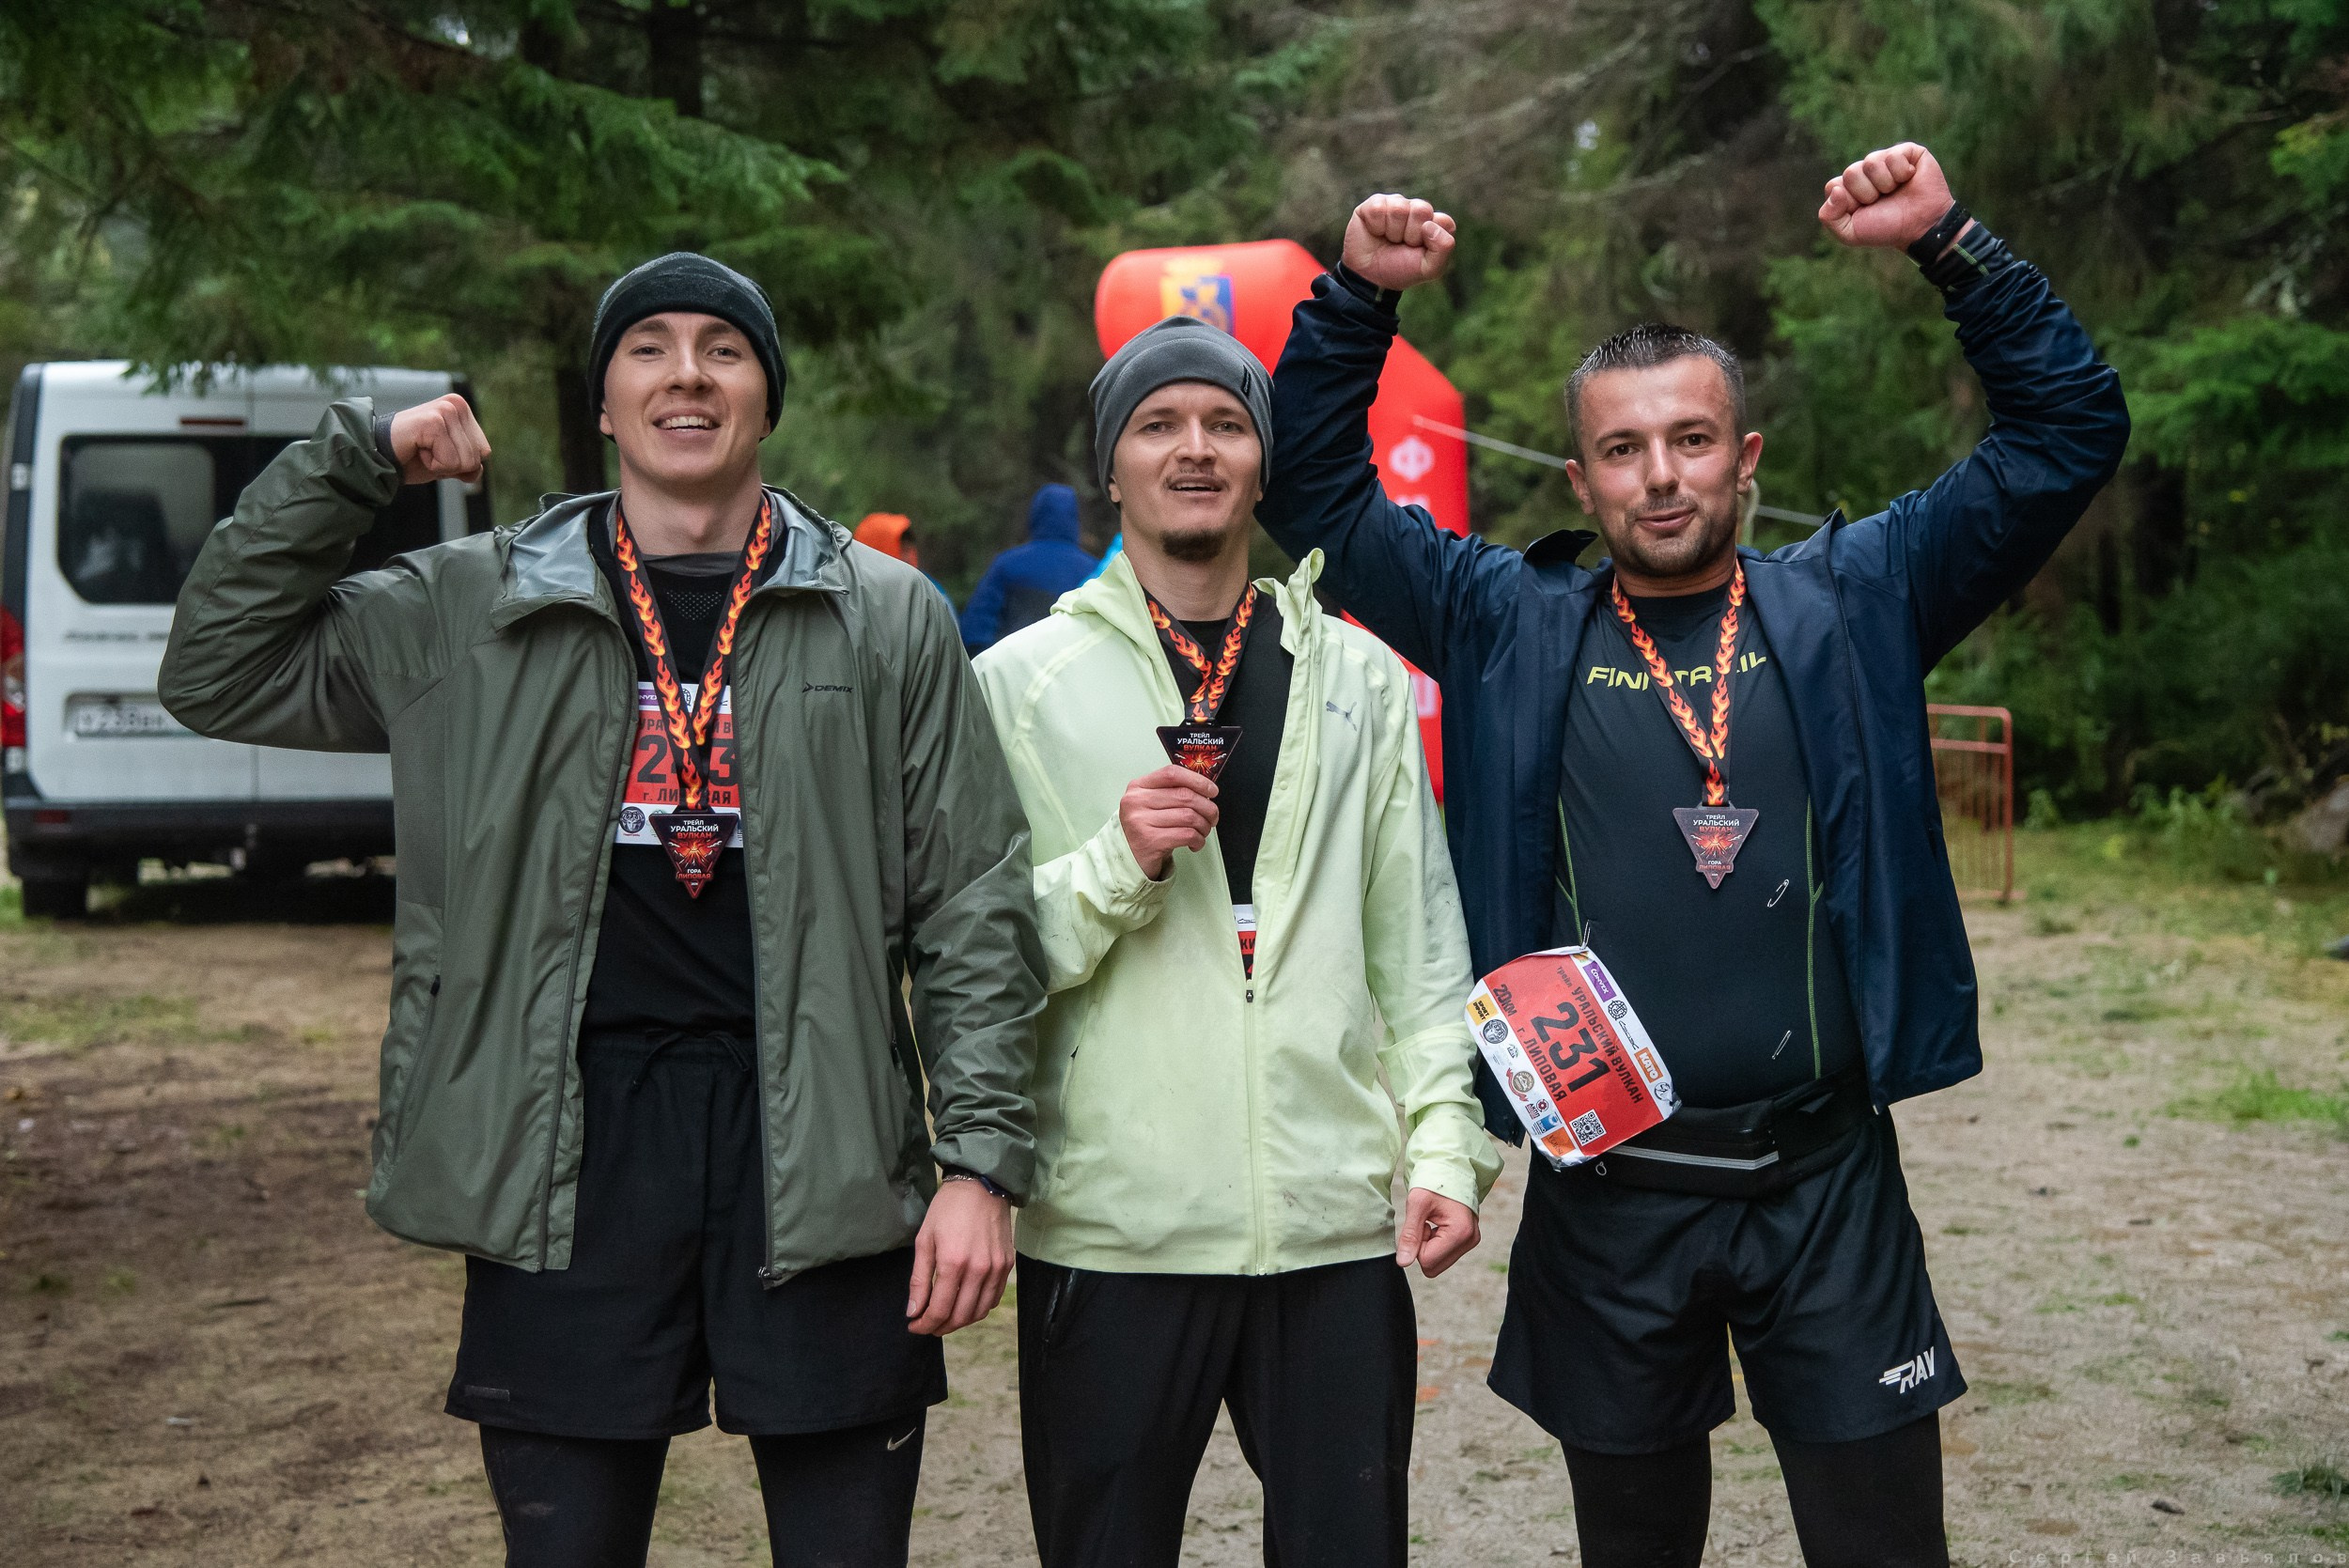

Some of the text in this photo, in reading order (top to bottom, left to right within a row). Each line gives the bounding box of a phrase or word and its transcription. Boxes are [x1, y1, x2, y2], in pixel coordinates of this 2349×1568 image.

[1586, 652, 1767, 691] FINTRIL
[814, 685, 854, 693] DEMIX
[637, 735, 739, 786] 23
[658, 788, 731, 804] ЛИАЯ
[671, 824, 719, 832] УРАЛЬСКИЙ
[1590, 968, 1610, 994] CONVEX
[1472, 1001, 1486, 1020] IMPORT
[1478, 1001, 1490, 1017] SPORT
[1531, 1001, 1611, 1093] 231
[1571, 986, 1619, 1057] УРАЛЬСКИЙ
[1611, 1052, 1644, 1104] ВУЛКАН
[1523, 1037, 1567, 1102] ЛИПОВАЯ
